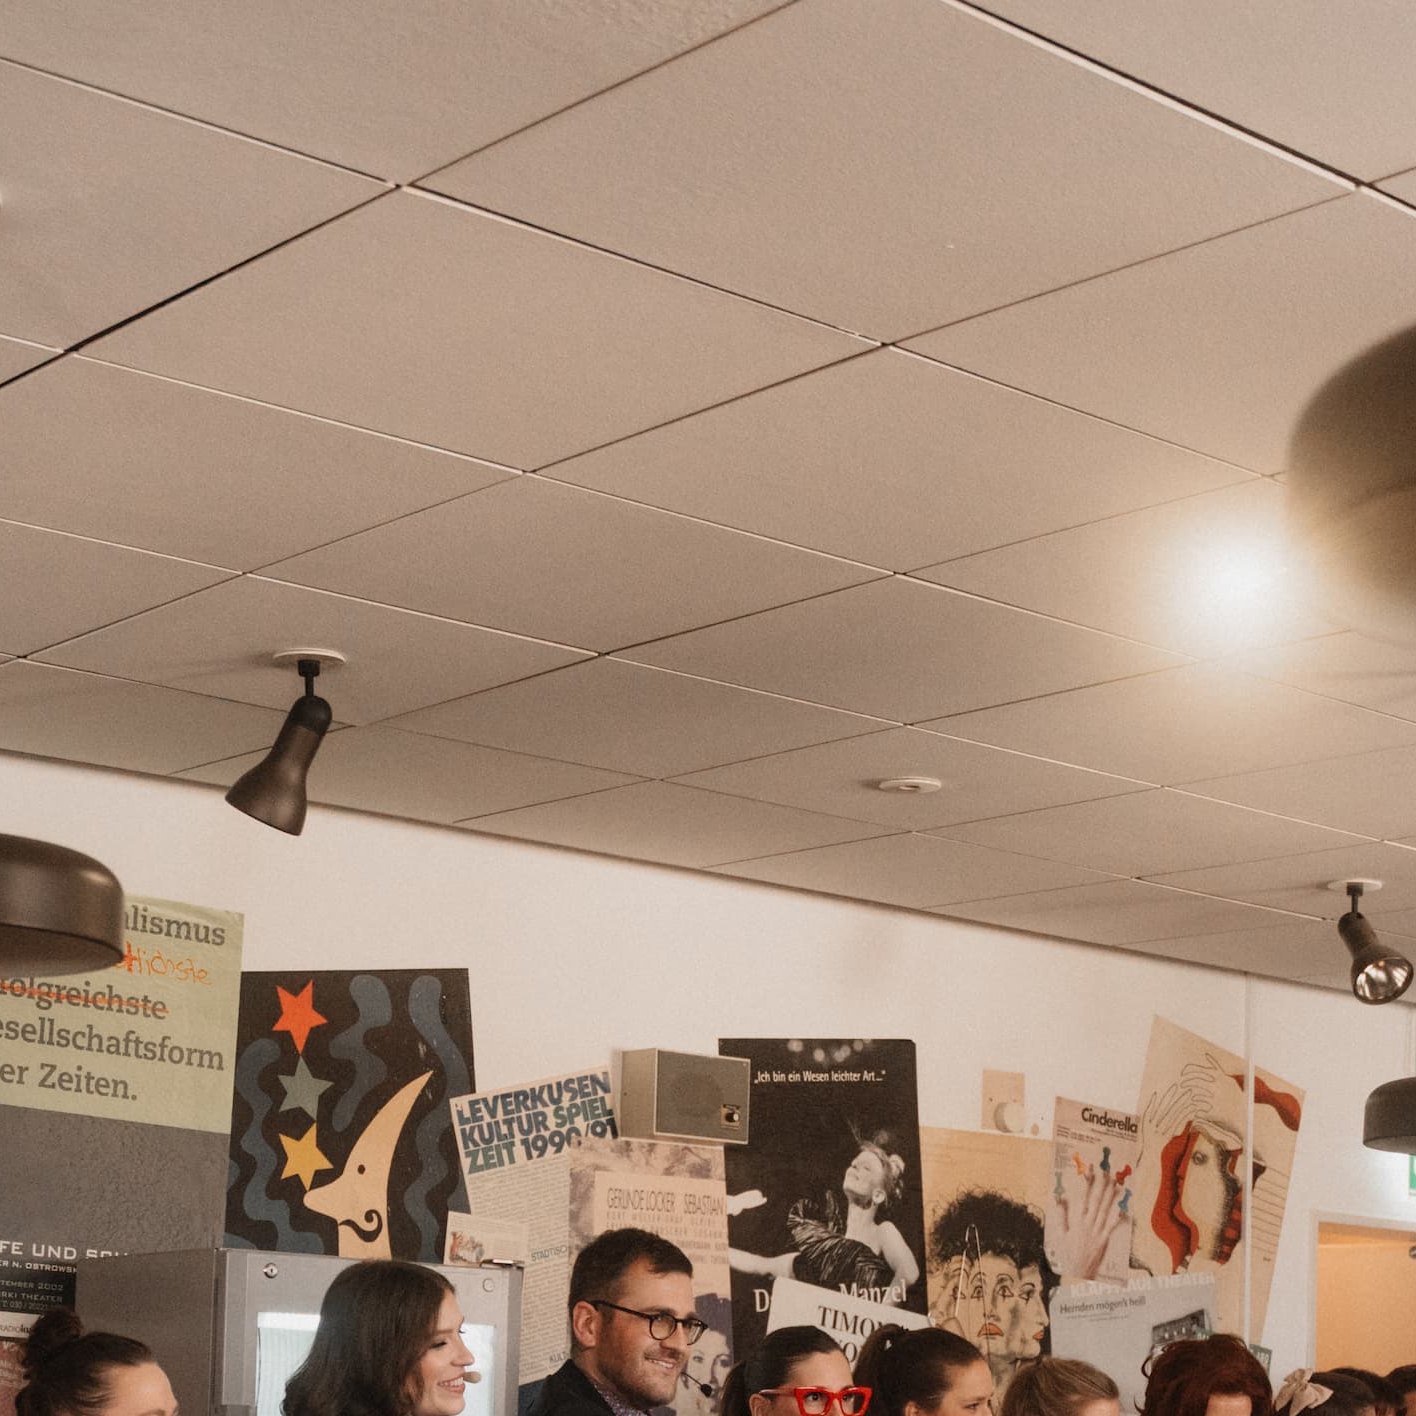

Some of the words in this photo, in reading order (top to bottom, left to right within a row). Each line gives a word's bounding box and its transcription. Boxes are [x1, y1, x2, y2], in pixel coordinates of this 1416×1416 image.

[38, 1063, 138, 1101] Zeiten.
[772, 1071, 786, 1082] bin
[788, 1071, 801, 1082] ein
[802, 1071, 829, 1082] Wesen
[831, 1070, 861, 1082] leichter
[456, 1072, 612, 1126] LEVERKUSEN
[459, 1110, 550, 1150] KULTUR
[553, 1095, 614, 1128] SPIEL
[1081, 1107, 1138, 1134] Cinderella
[465, 1142, 516, 1175] ZEIT
[32, 1243, 77, 1260] UND
[11, 1261, 23, 1269] N.
[21, 1292, 63, 1304] THEATER
[839, 1279, 907, 1304] Manzel
[1060, 1302, 1094, 1315] Hemden
